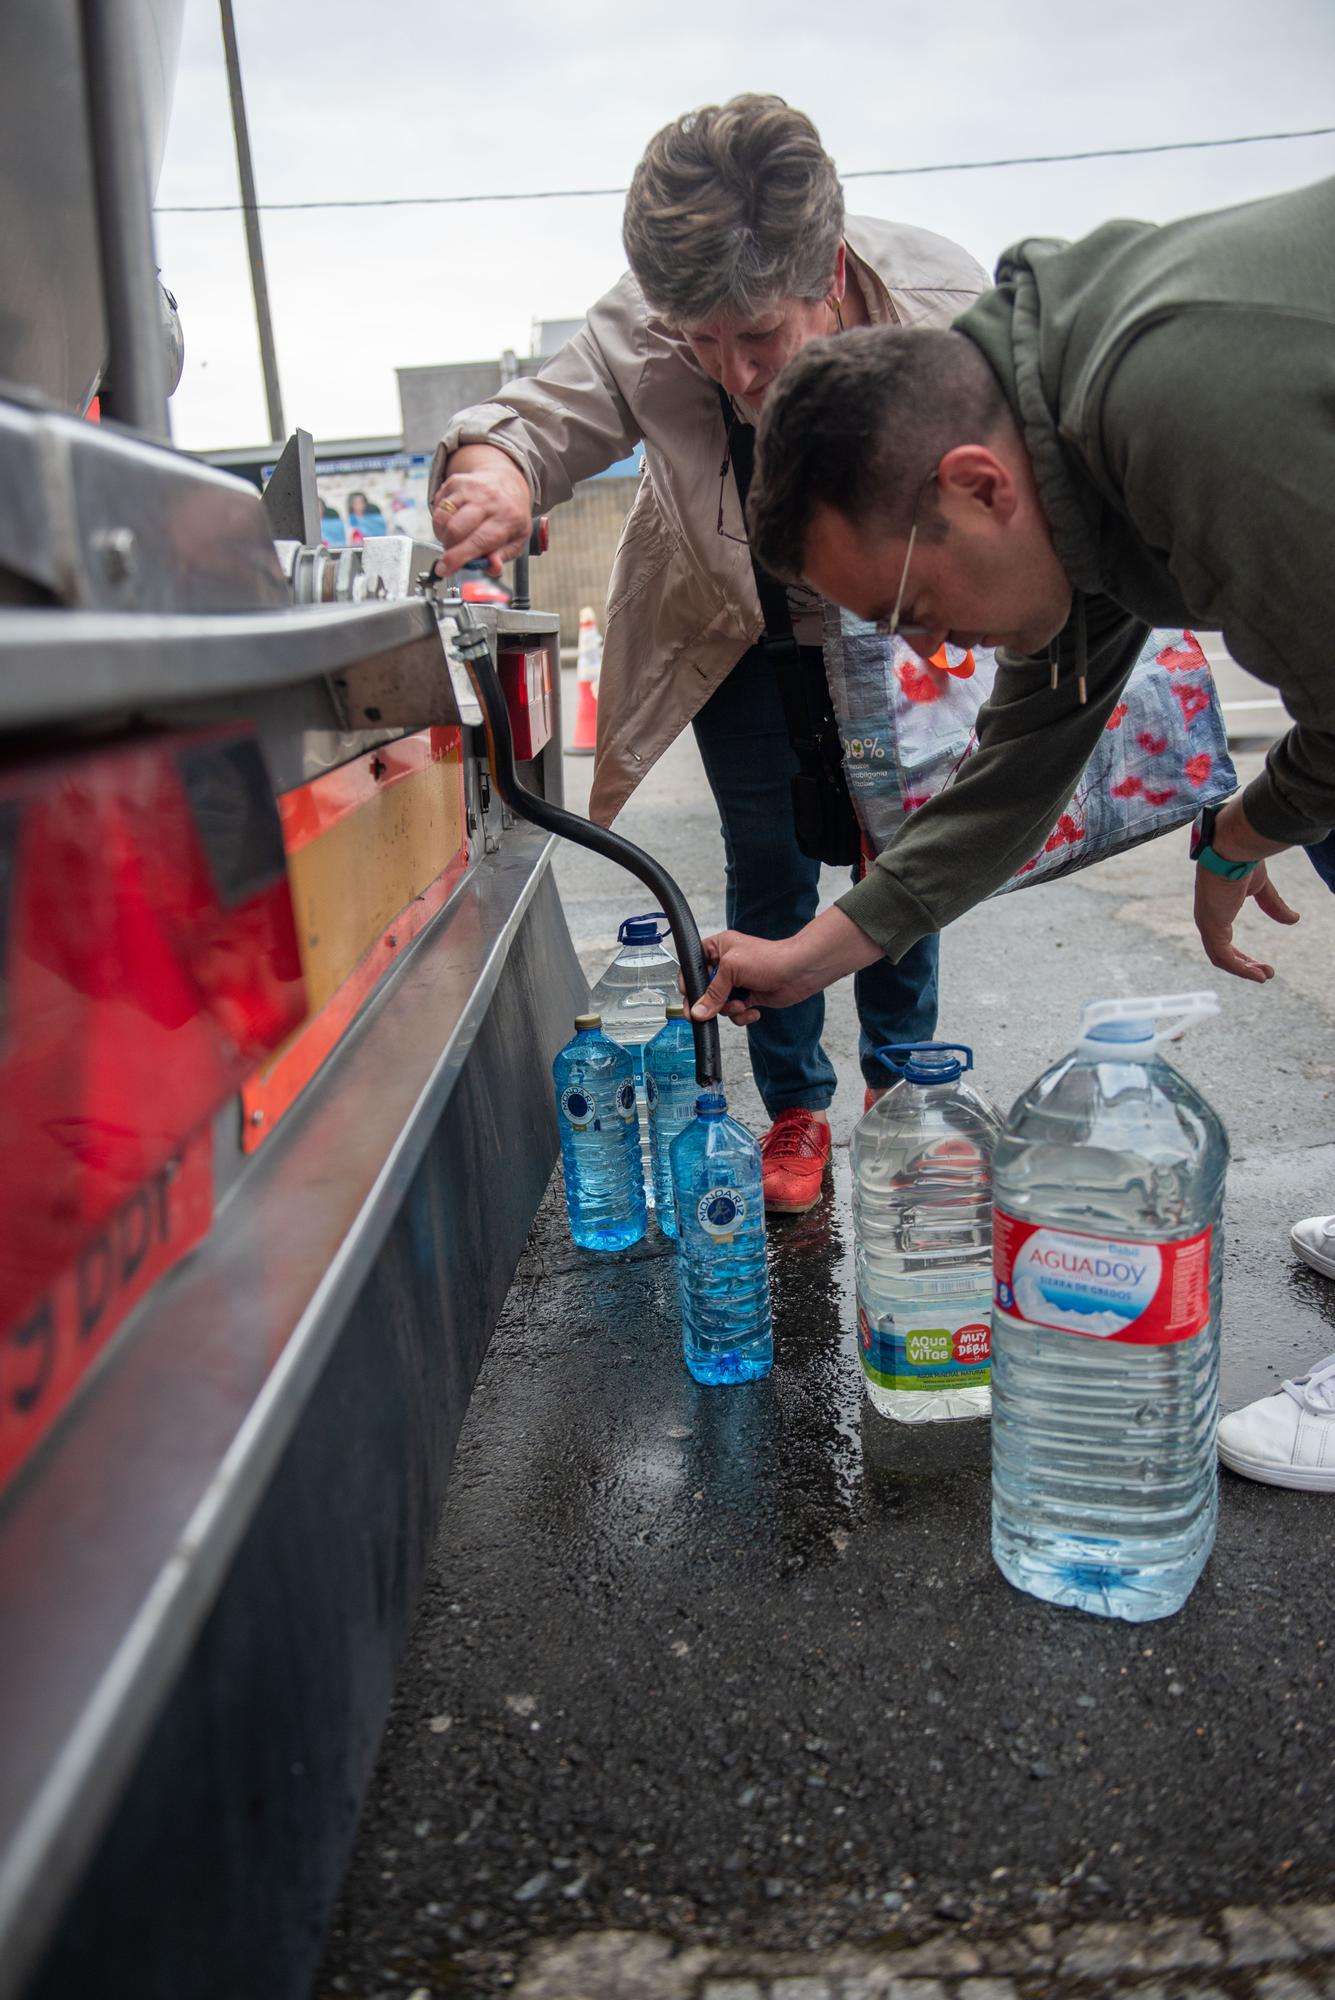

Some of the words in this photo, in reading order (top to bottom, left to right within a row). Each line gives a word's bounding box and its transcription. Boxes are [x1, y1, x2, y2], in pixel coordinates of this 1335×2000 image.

[561, 1087, 595, 1112] MONDARIZ
[698, 1189, 745, 1222] MONDARIZ
[1030, 1248, 1147, 1287] AGUADOY
[1039, 1275, 1073, 1290] SIERRA
[1074, 1282, 1088, 1293] DE
[1090, 1286, 1133, 1301] GREDOS
[957, 1342, 991, 1357] DÉBIL
[960, 1331, 987, 1344] MUY
